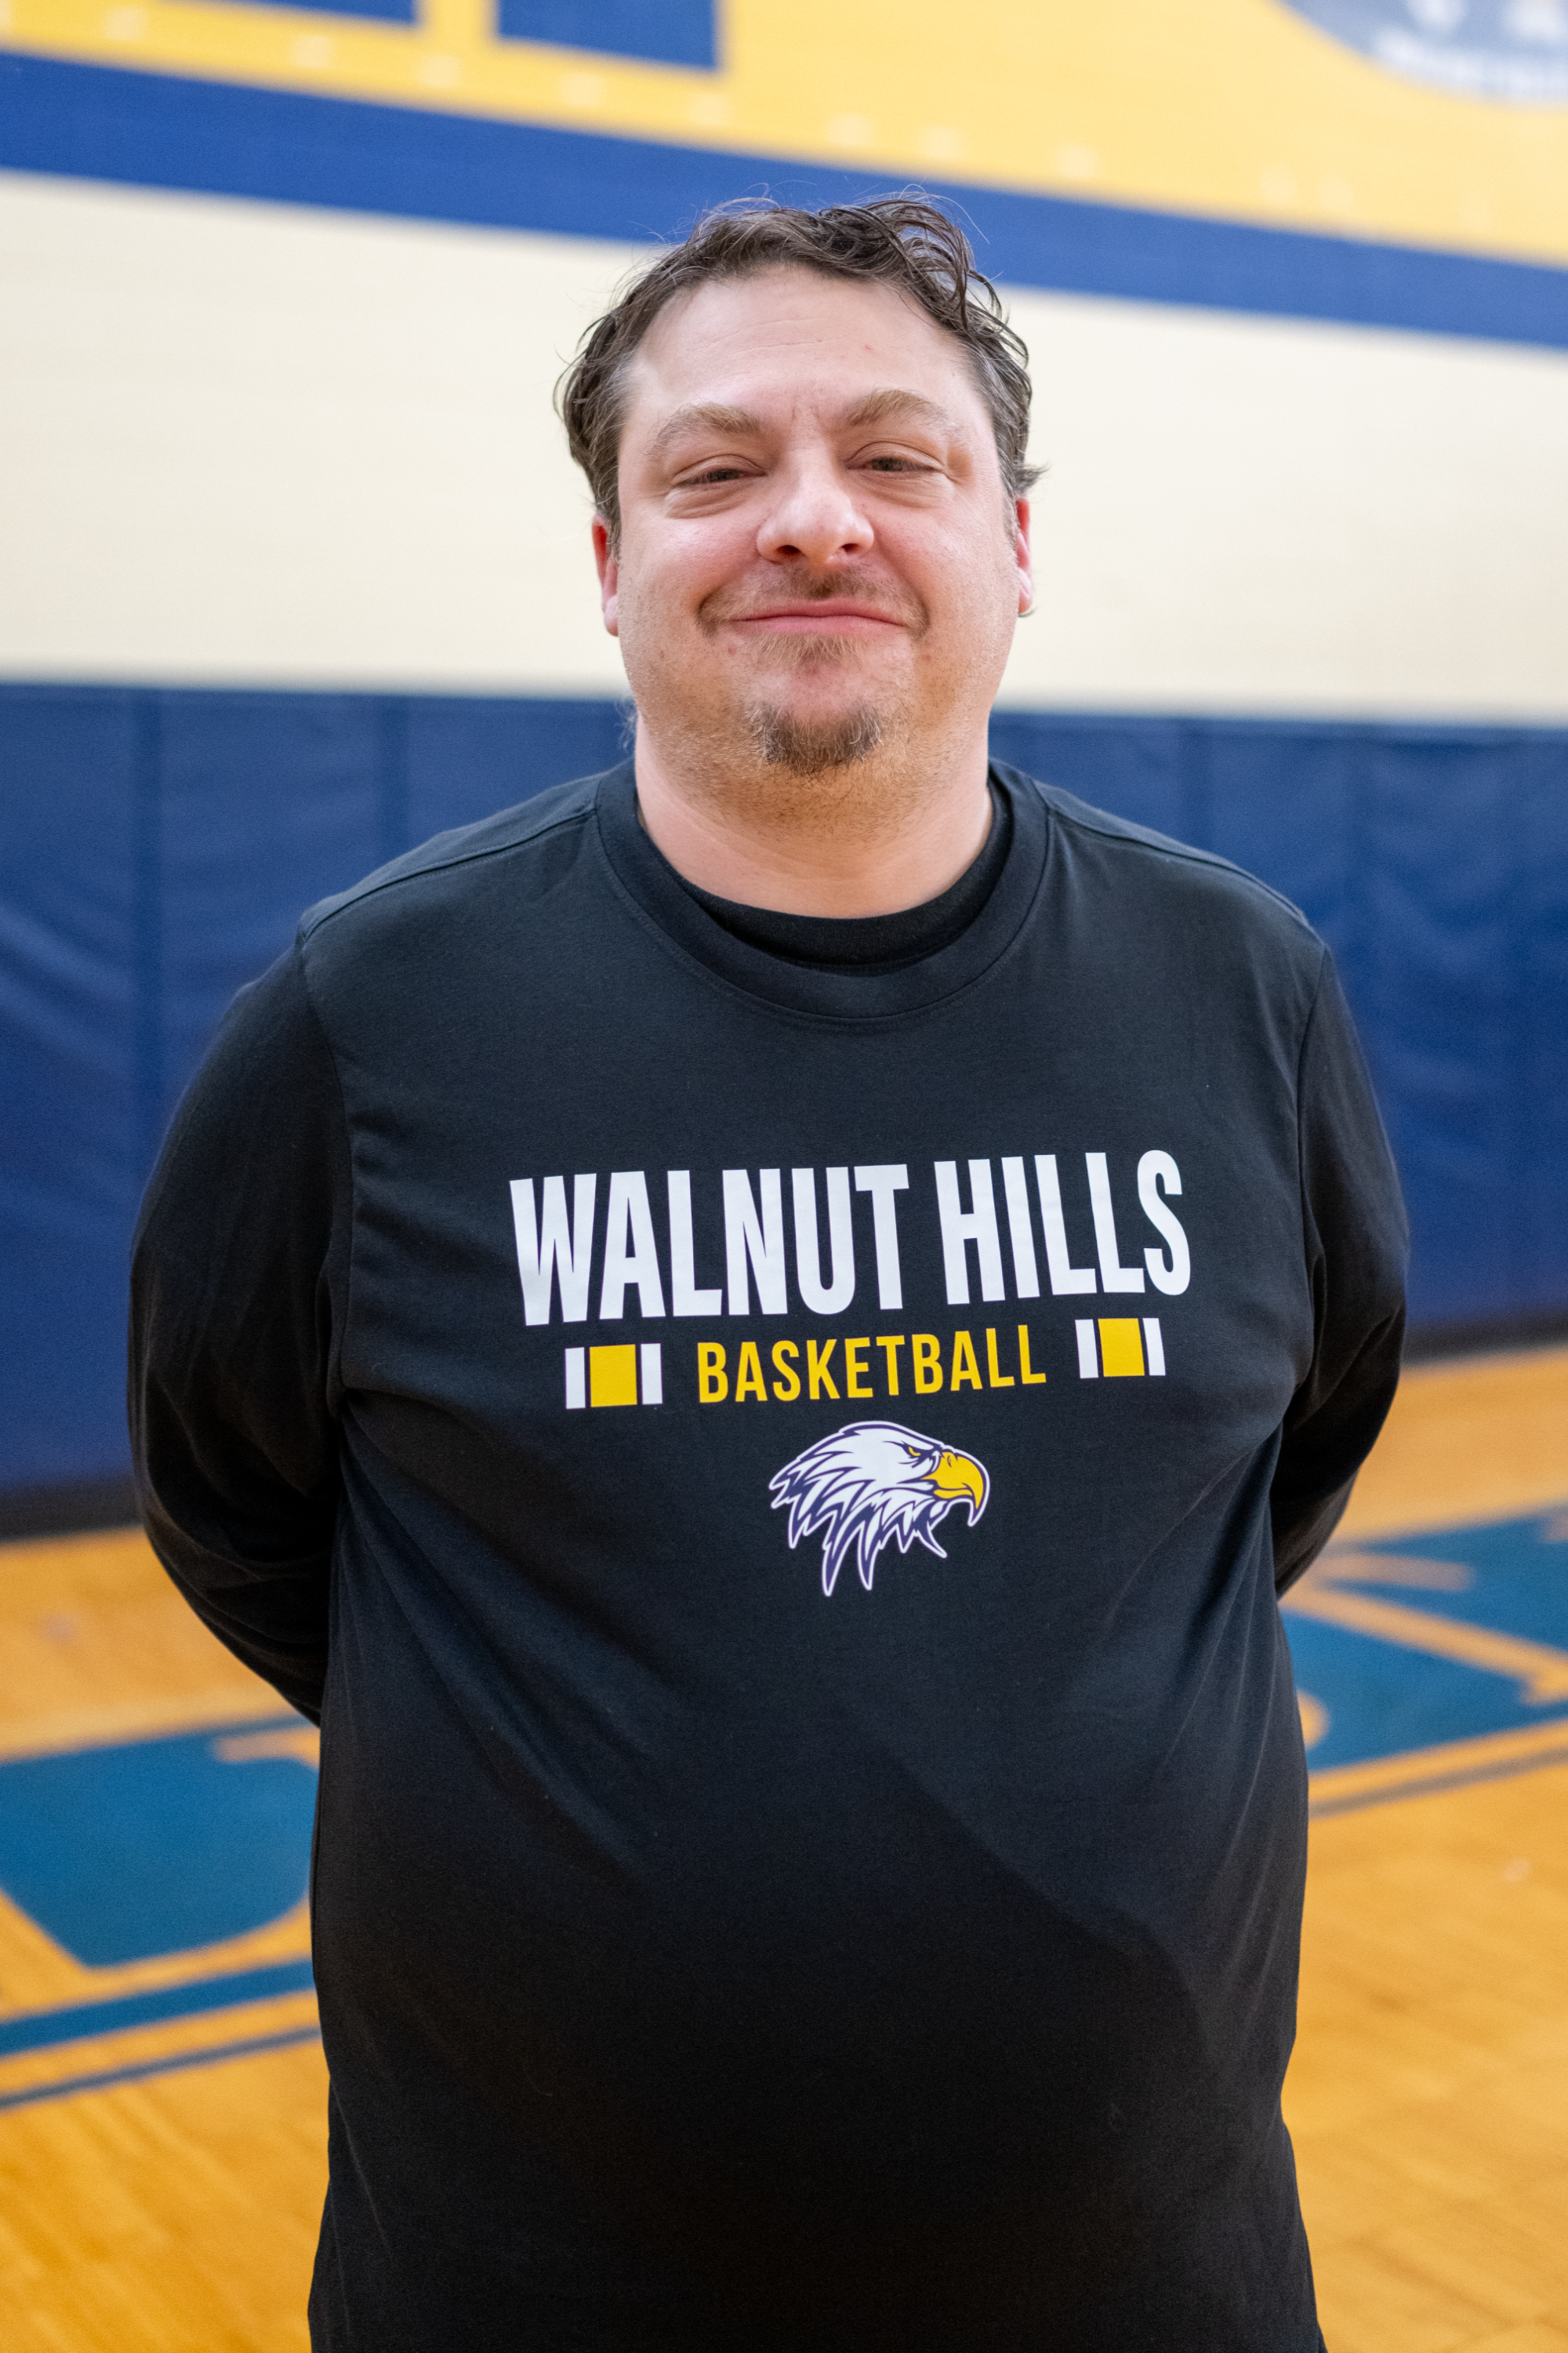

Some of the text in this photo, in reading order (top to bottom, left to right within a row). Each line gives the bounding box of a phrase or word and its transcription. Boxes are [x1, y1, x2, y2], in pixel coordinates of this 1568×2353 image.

[510, 1150, 1190, 1326] WALNUT HILLS
[698, 1325, 1046, 1403] BASKETBALL
